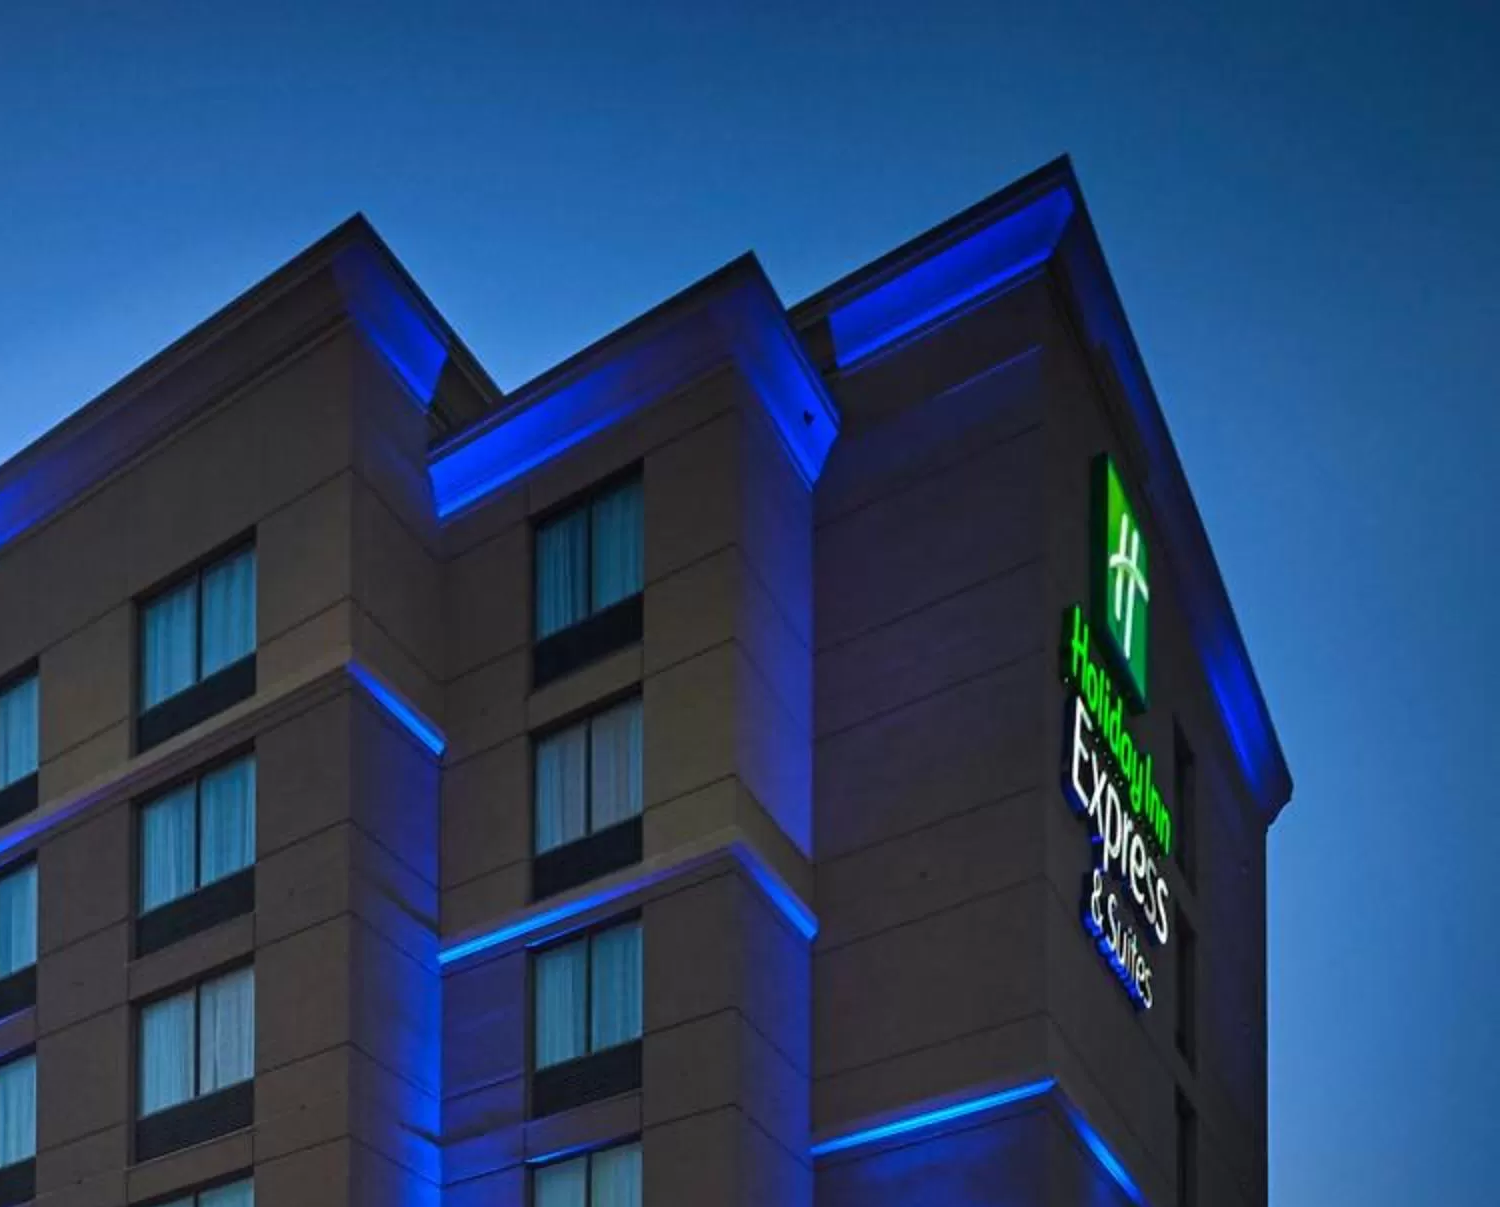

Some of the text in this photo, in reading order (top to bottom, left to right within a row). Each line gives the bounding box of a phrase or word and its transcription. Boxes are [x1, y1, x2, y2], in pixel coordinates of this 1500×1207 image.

[1071, 605, 1171, 856] Holiday Inn
[1071, 696, 1169, 945] Express
[1091, 868, 1153, 1009] & Suites
